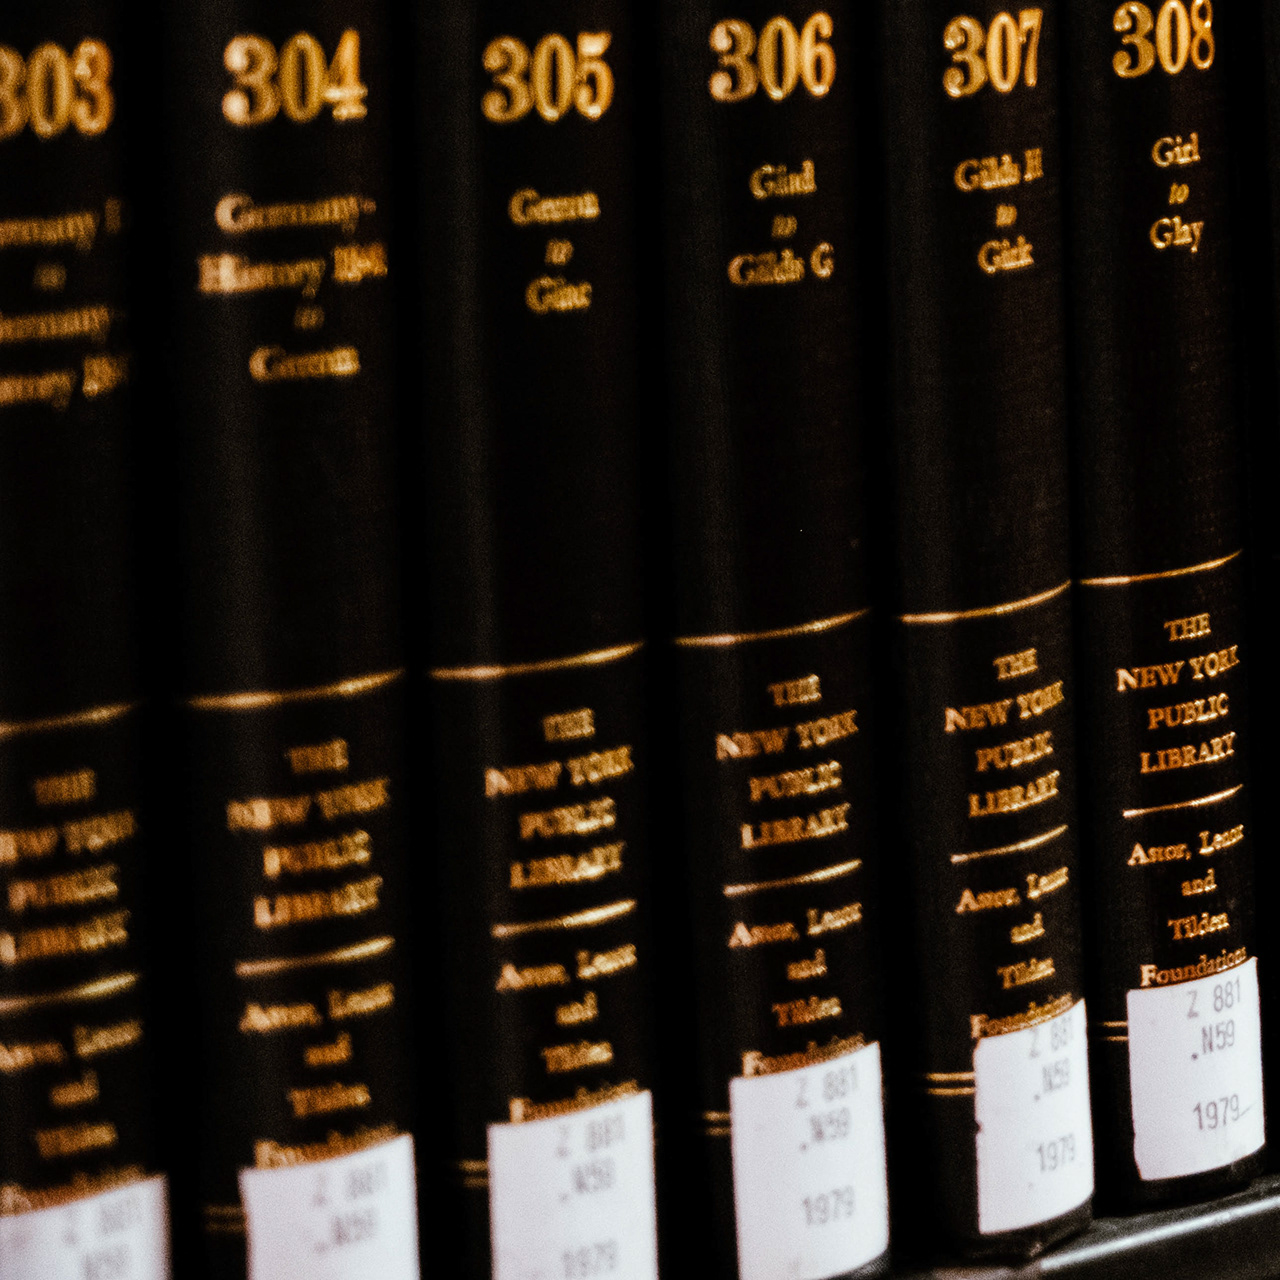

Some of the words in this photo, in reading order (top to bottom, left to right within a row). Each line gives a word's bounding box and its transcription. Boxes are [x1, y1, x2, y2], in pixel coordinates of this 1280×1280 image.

[709, 12, 836, 101] 306
[943, 8, 1043, 98] 307
[222, 29, 368, 126] 304
[484, 32, 614, 122] 305
[1164, 613, 1211, 641] THE
[1116, 661, 1185, 692] NEW
[1189, 645, 1240, 680] YORK
[1148, 693, 1228, 729] PUBLIC
[1141, 731, 1236, 773] LIBRARY
[1182, 868, 1217, 896] and
[1193, 1094, 1239, 1130] 1979
